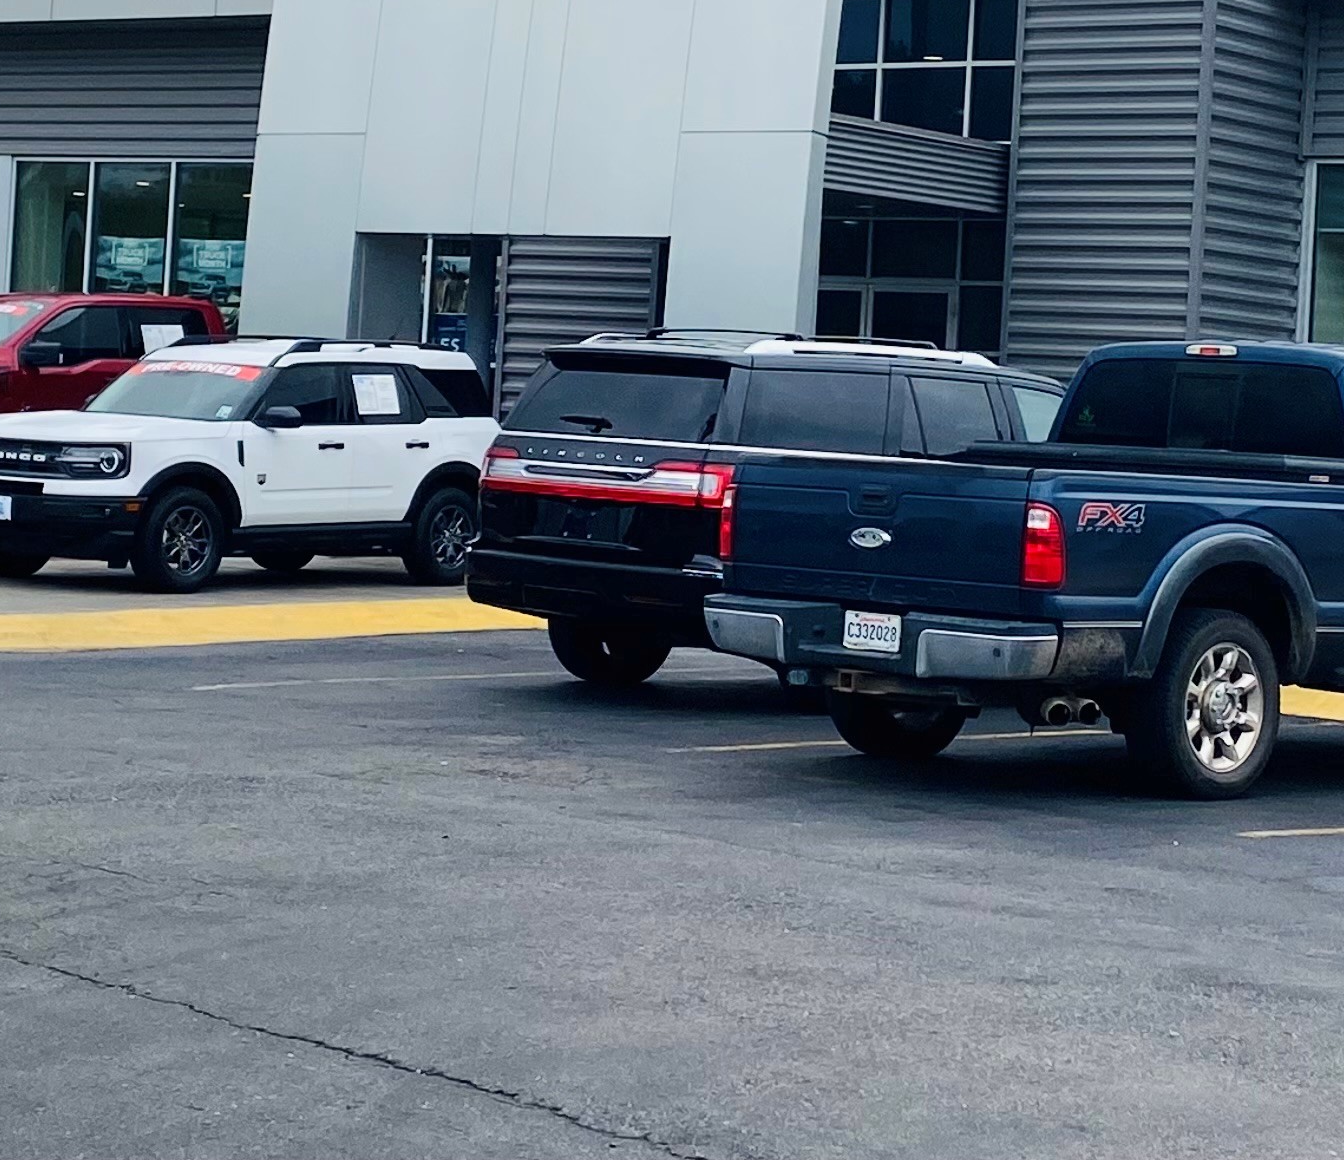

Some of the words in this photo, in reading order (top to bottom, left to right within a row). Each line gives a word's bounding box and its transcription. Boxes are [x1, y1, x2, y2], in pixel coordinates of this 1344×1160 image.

[141, 361, 242, 377] PRE-OWNED
[527, 447, 644, 462] LINCOLN
[1078, 502, 1145, 528] FX4
[847, 621, 897, 642] C332028
